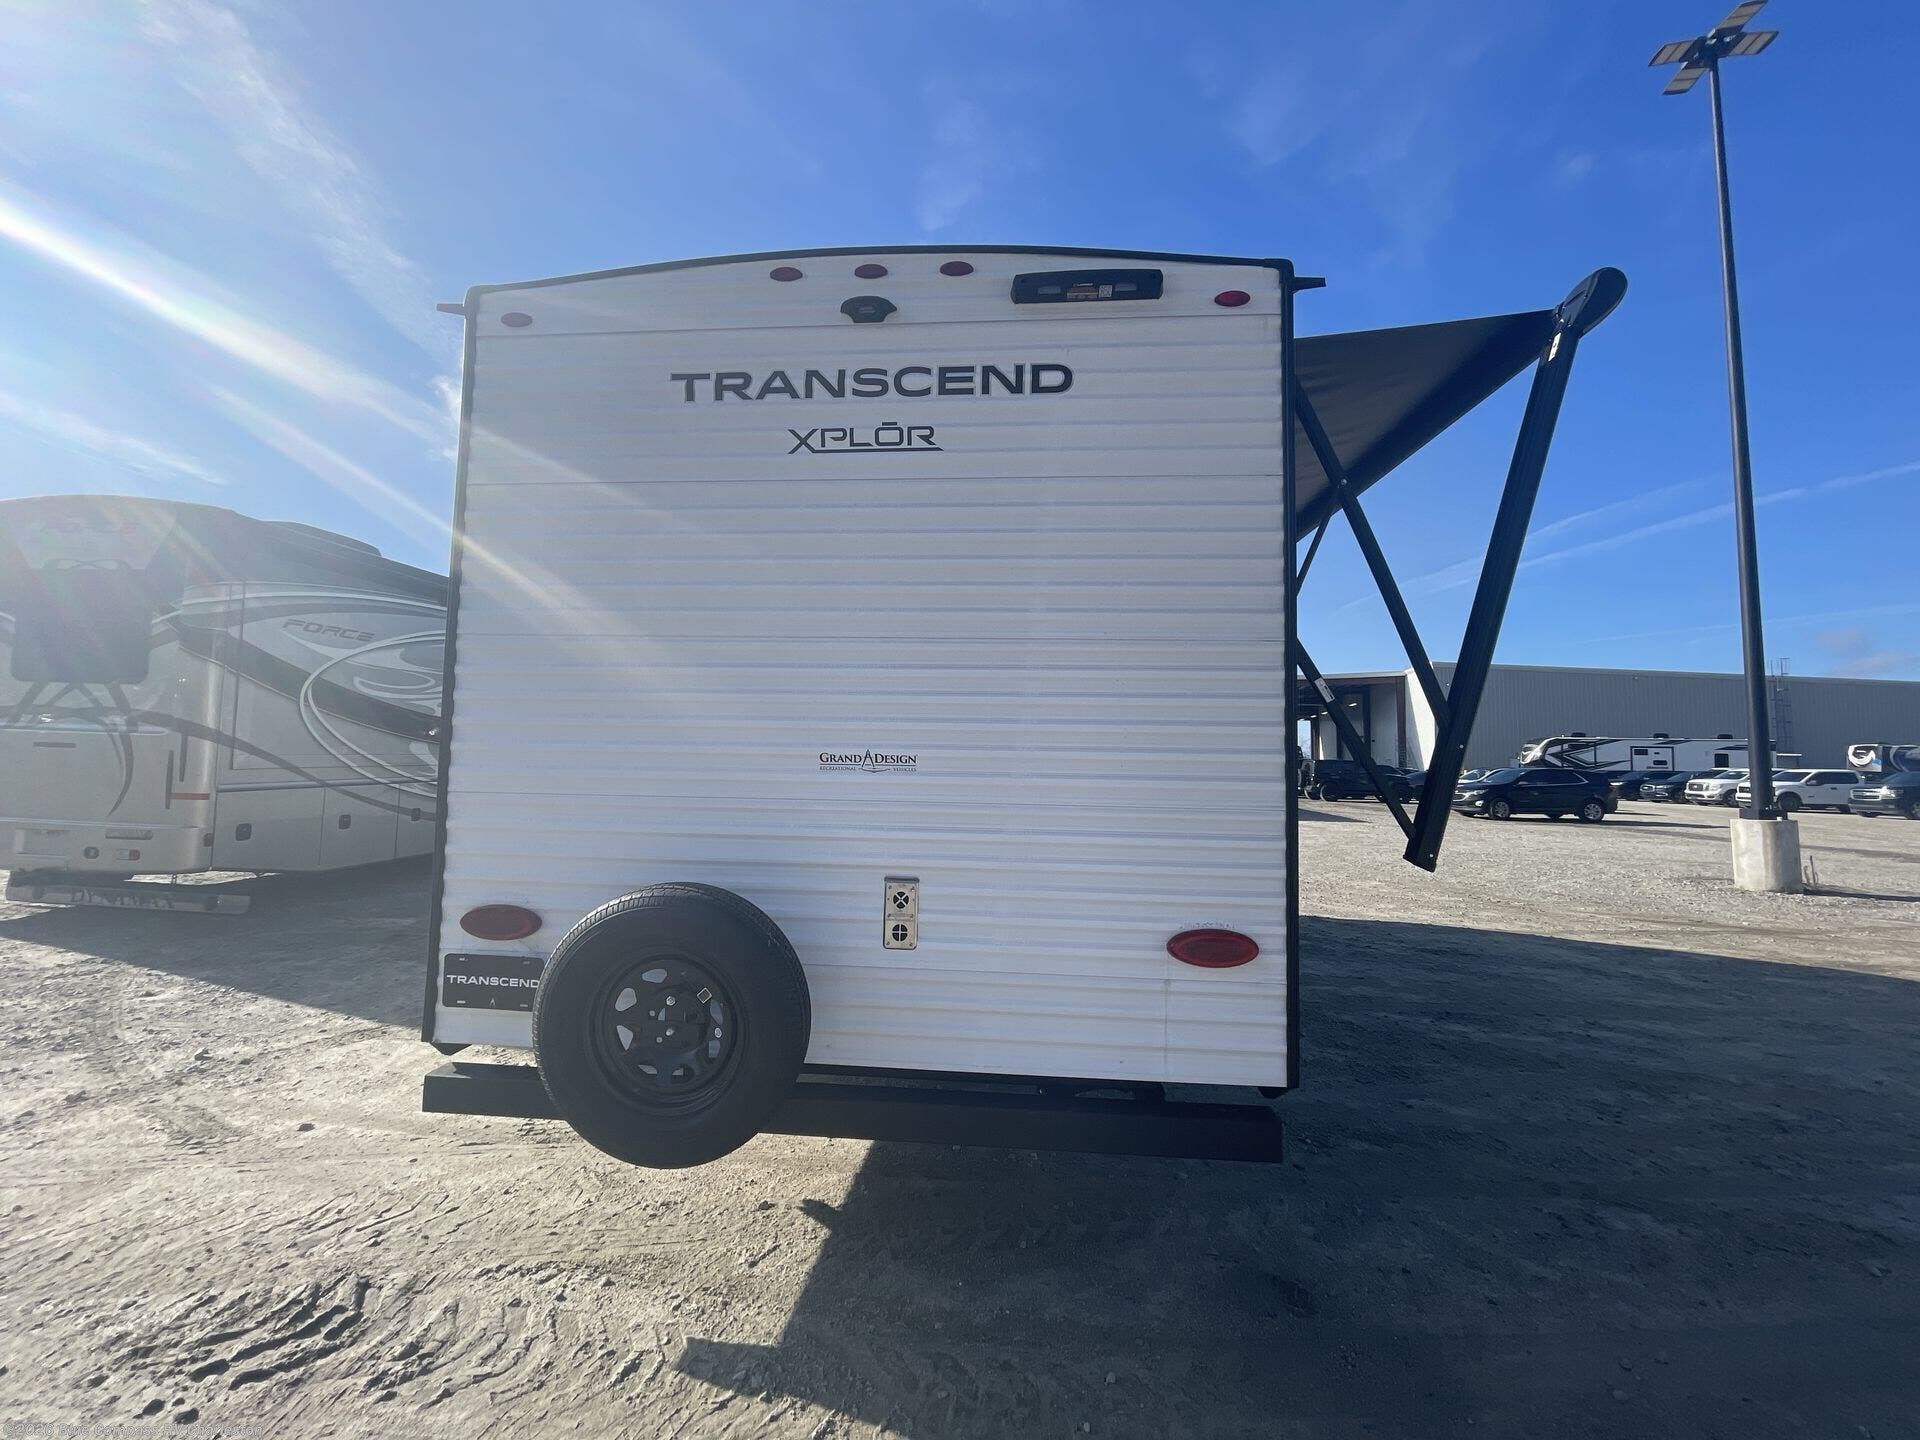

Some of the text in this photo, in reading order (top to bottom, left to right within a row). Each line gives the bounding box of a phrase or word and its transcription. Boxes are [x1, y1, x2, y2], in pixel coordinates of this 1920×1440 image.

[670, 363, 1075, 402] TRANSCEND
[282, 618, 375, 642] FORCE
[819, 752, 917, 764] GRAND DESIGN
[446, 974, 541, 988] TRANSCEND
